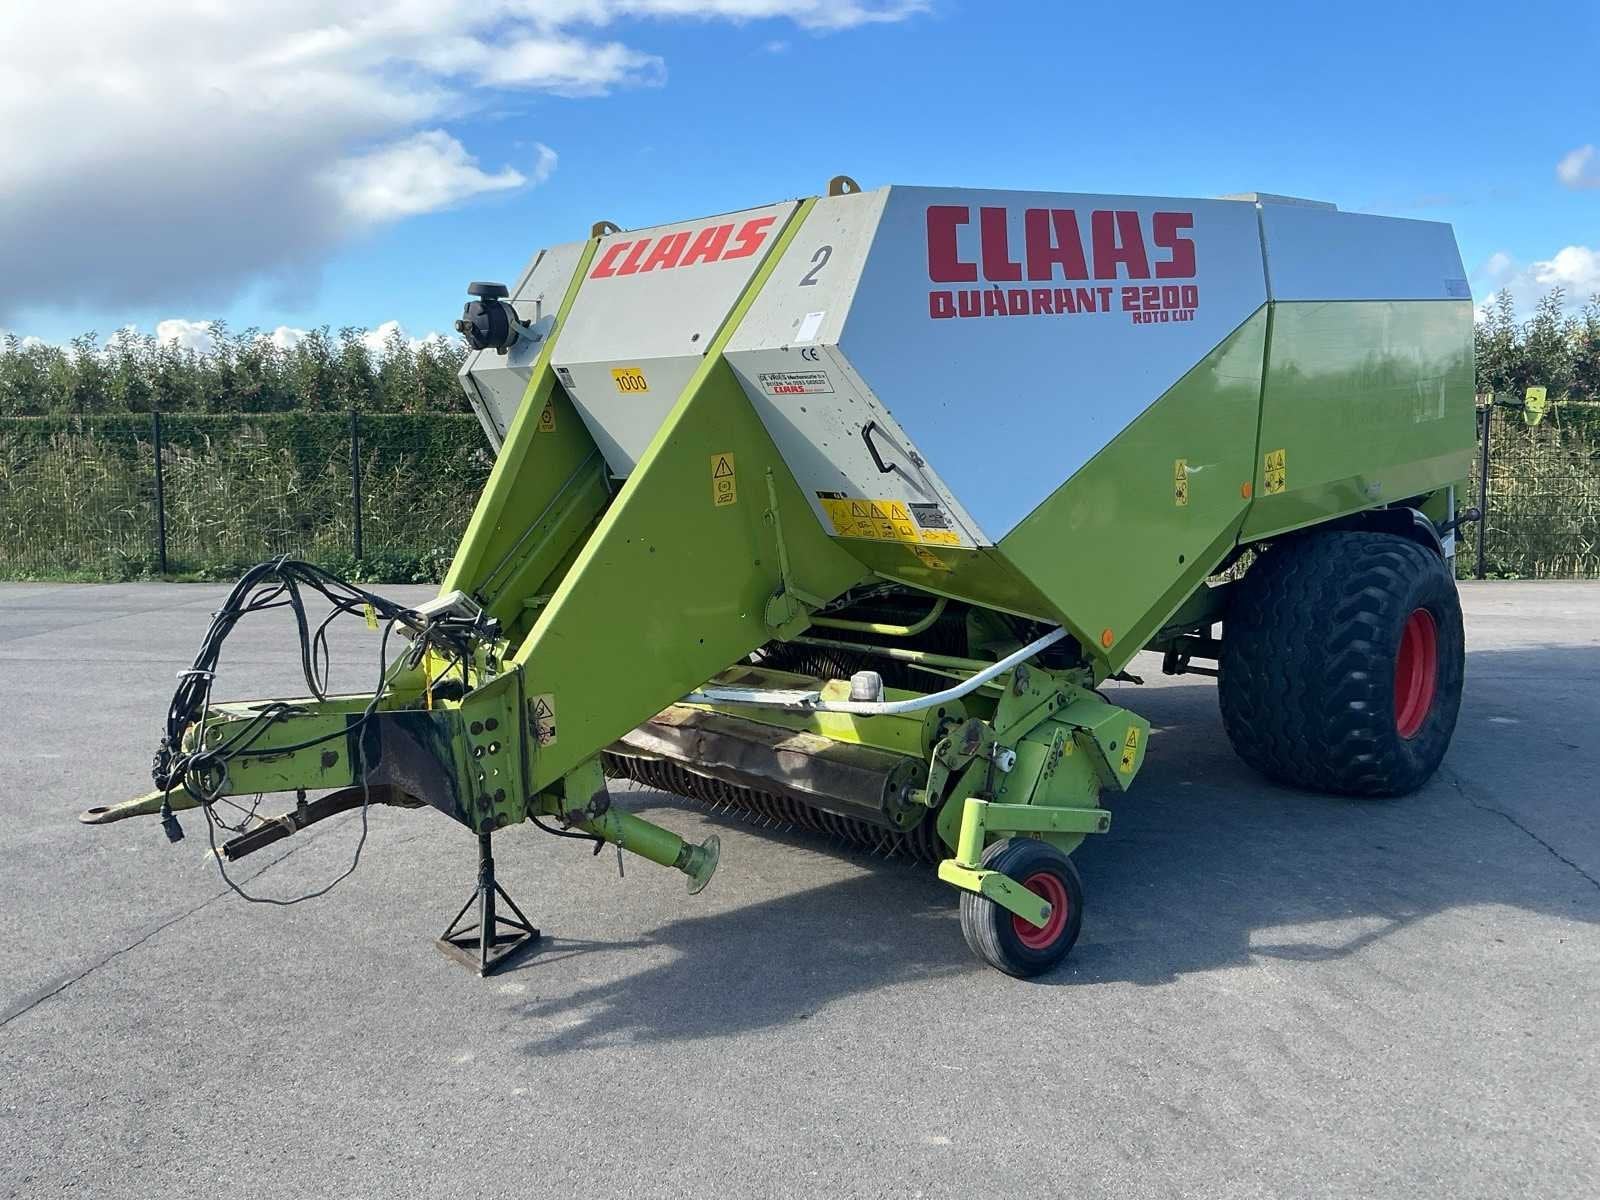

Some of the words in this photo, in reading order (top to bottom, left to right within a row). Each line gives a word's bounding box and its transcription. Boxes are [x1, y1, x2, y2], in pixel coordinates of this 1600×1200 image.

[590, 216, 778, 279] CLAAS
[926, 205, 1197, 283] CLAAS
[799, 245, 833, 287] 2
[929, 287, 1113, 319] QUADRANT
[1122, 285, 1199, 311] 2200
[1132, 310, 1169, 324] ROTO
[1172, 309, 1195, 322] CUT
[615, 375, 647, 391] 1000
[773, 385, 805, 393] CLAAS
